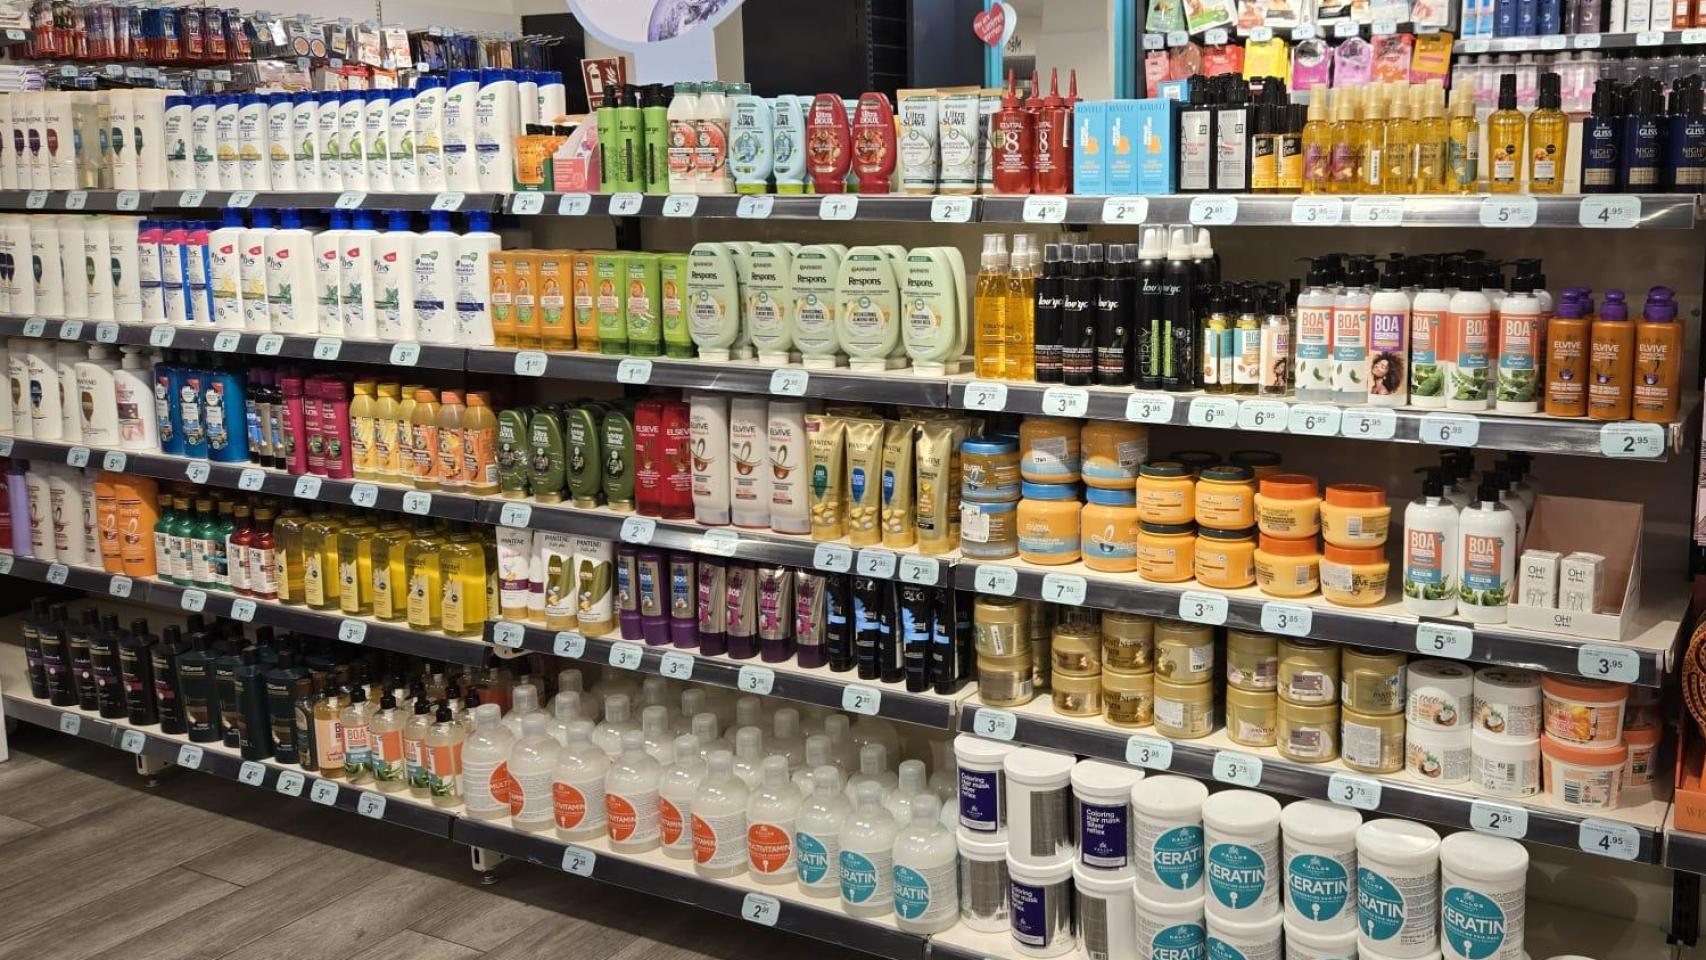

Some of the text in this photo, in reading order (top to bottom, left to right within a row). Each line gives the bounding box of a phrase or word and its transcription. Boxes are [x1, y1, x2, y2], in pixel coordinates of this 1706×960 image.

[906, 111, 924, 119] Ultra
[945, 111, 964, 119] Ultra
[1593, 129, 1612, 137] GLISS
[1639, 128, 1657, 136] GLISS
[1005, 131, 1019, 153] 8
[1039, 131, 1048, 153] 8
[1598, 207, 1624, 222] 4.95
[691, 271, 717, 281] Respons
[751, 271, 776, 281] Respons
[797, 273, 827, 284] Respons
[848, 277, 882, 287] Respons
[907, 278, 933, 287] Respons
[1302, 312, 1324, 327] BOA
[1337, 313, 1360, 329] BOA
[1375, 315, 1399, 332] BOA
[1466, 320, 1488, 336] BOA
[1506, 320, 1531, 336] BOA
[1554, 340, 1582, 350] ELVIVE
[1592, 343, 1620, 353] ELVIVE
[1639, 343, 1668, 353] ELVIVE
[1142, 404, 1160, 418] 3.95
[1205, 409, 1224, 422] 6.95
[1255, 411, 1275, 425] 6.95
[1306, 416, 1326, 430] 6.95
[636, 425, 659, 433] ELSEVE
[733, 425, 755, 433] ELVIVE
[769, 427, 792, 436] ELVIVE
[1360, 418, 1381, 433] 5.95
[1440, 425, 1462, 440] 6.95
[1623, 436, 1648, 452] 2.95
[576, 540, 601, 548] PANTENE
[1411, 531, 1435, 549] BOA
[1470, 537, 1494, 555] BOA
[1527, 565, 1545, 575] OH!
[1568, 568, 1585, 577] OH!
[673, 575, 687, 583] SOS
[1554, 614, 1572, 623] OH!
[1434, 636, 1457, 650] 5.95
[1599, 659, 1623, 674] 3.95
[961, 772, 985, 784] Coloring
[1344, 786, 1366, 800] 3.75
[1086, 809, 1115, 818] Coloring
[1086, 821, 1104, 829] Silver
[1489, 813, 1513, 828] 2.95
[1086, 827, 1104, 835] reflex
[1598, 835, 1623, 850] 4.95
[1208, 860, 1266, 884] KERATIN
[1289, 873, 1348, 895] KERATIN
[1443, 904, 1505, 935] KERATIN
